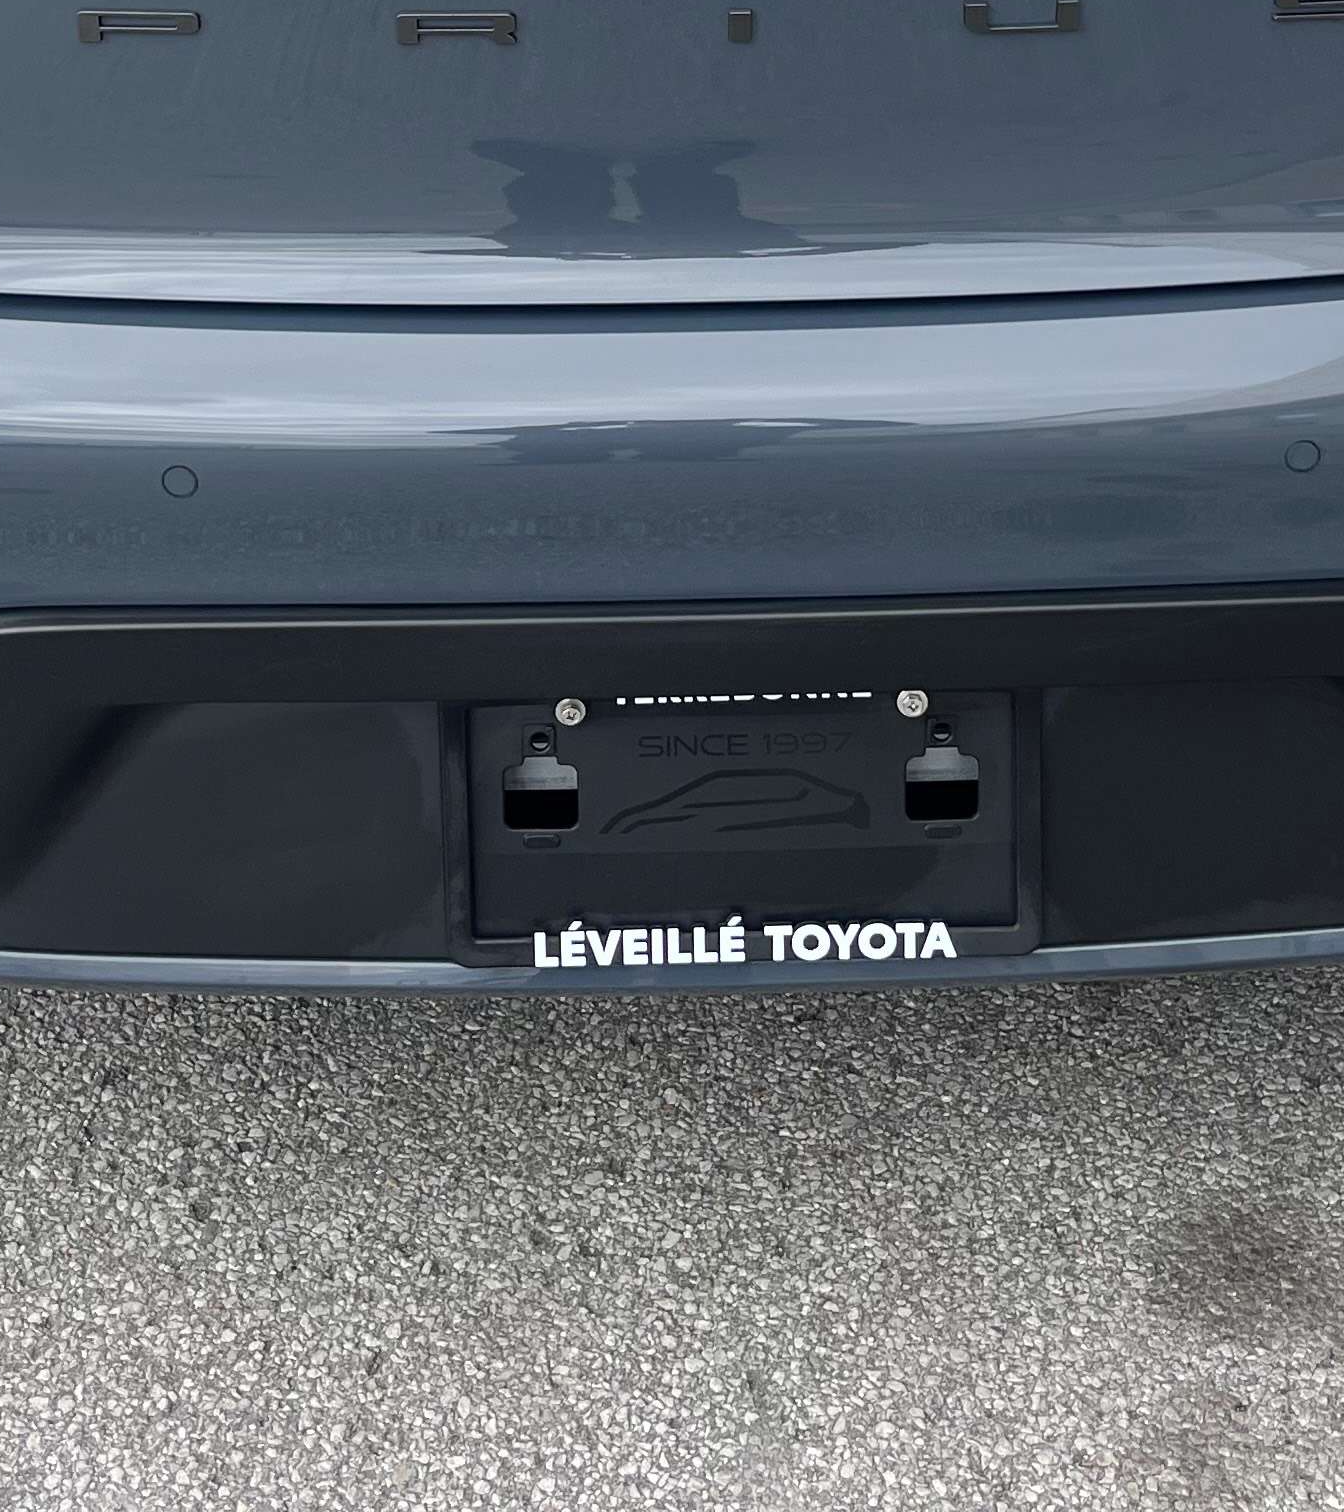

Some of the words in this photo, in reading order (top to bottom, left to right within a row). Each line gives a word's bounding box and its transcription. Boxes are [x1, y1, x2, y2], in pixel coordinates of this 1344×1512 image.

[638, 734, 749, 758] SINCE
[764, 732, 854, 755] 1997
[534, 916, 746, 968] LÉVEILLÉ
[763, 921, 957, 962] TOYOTA
